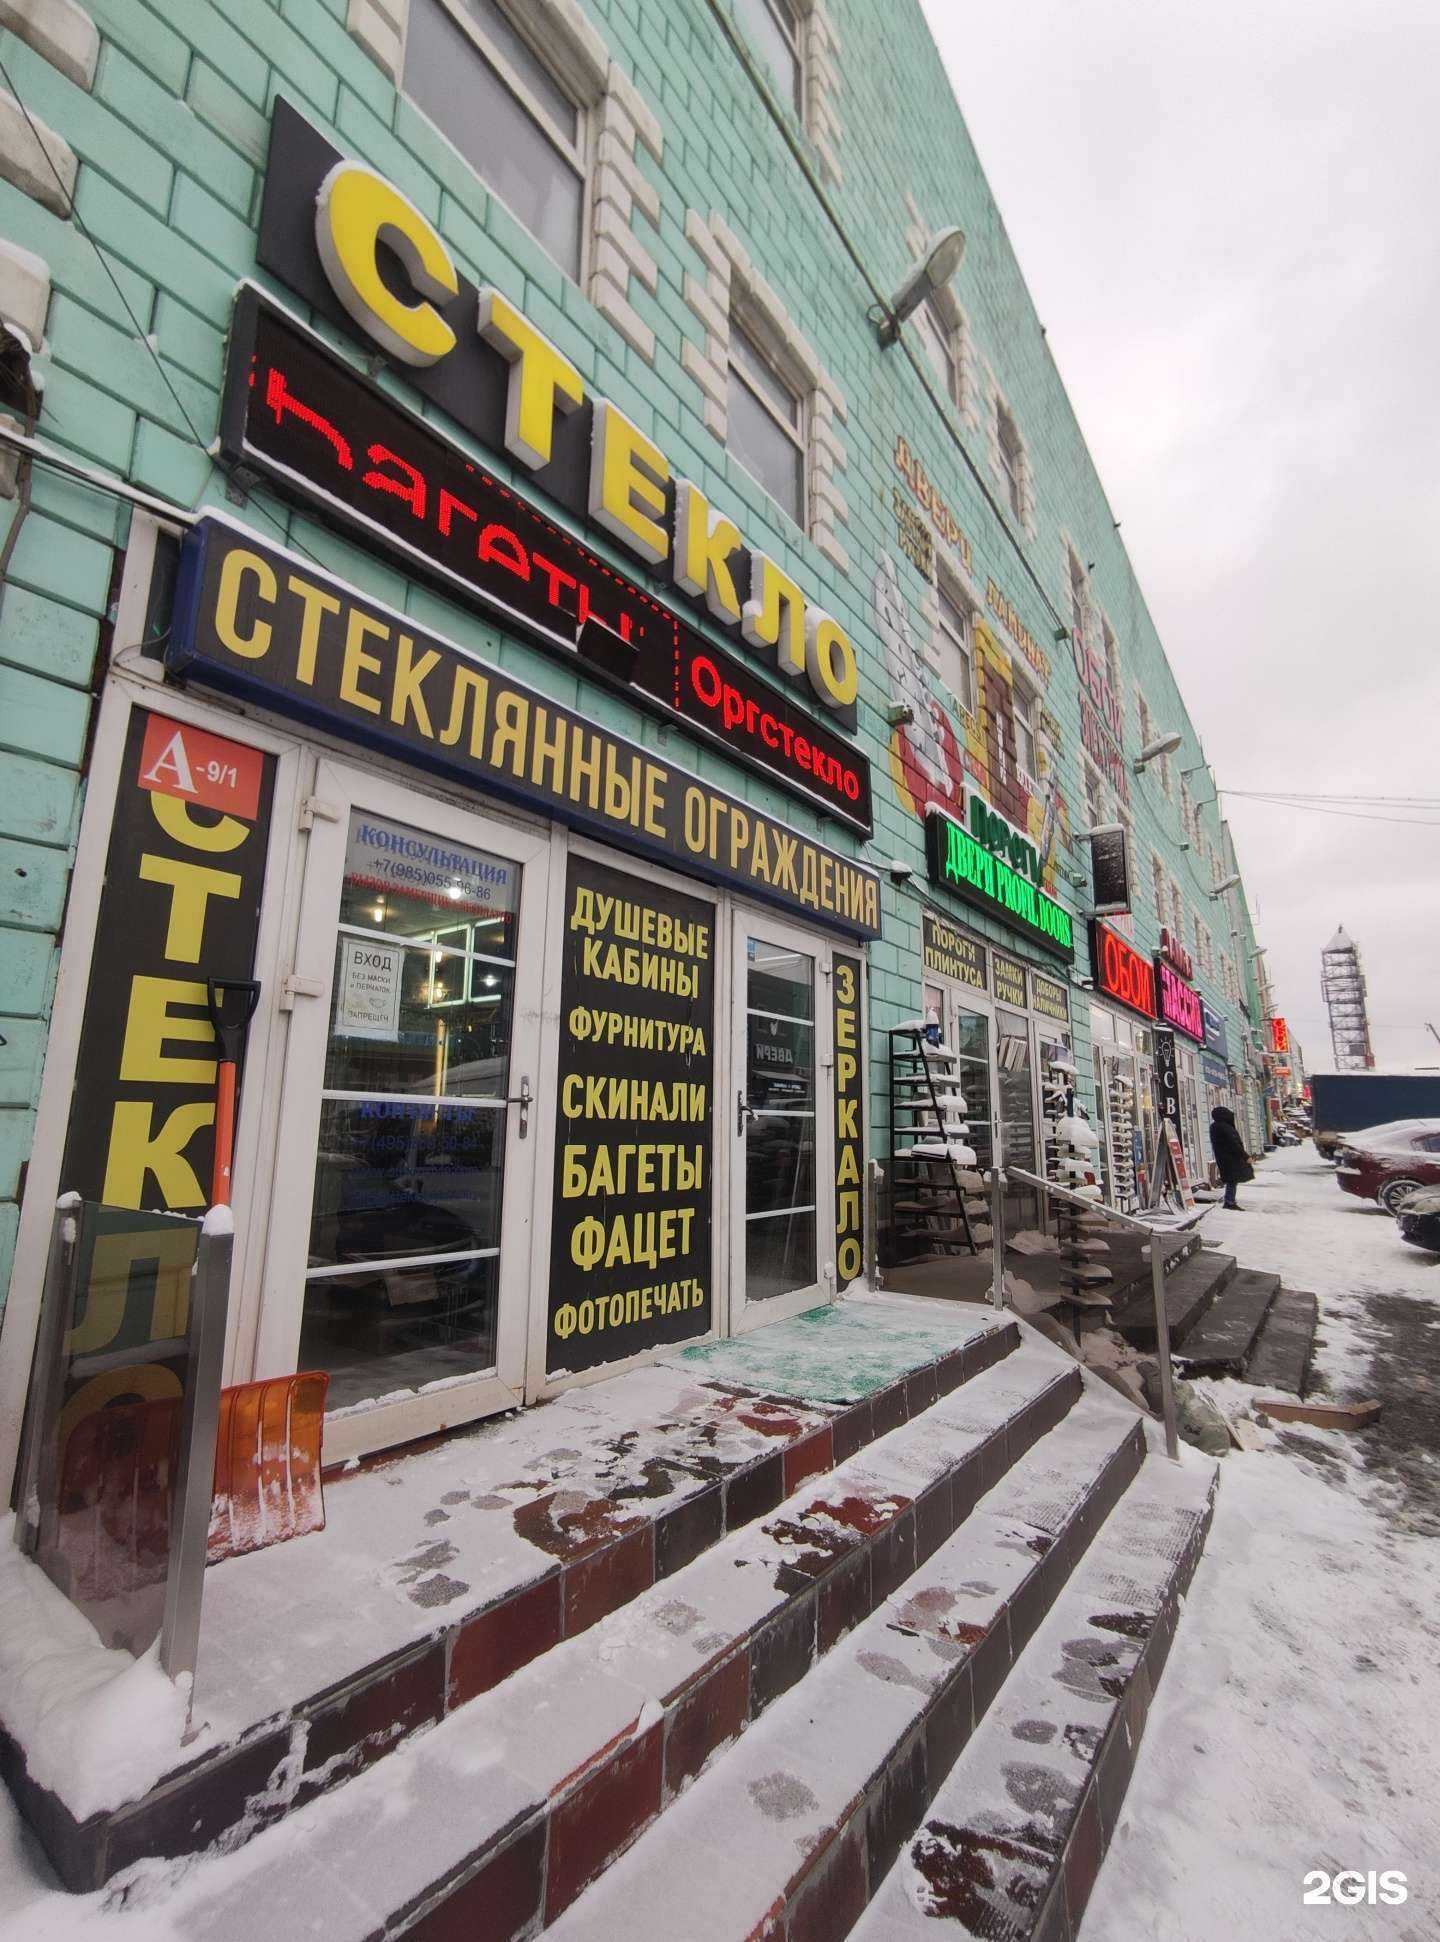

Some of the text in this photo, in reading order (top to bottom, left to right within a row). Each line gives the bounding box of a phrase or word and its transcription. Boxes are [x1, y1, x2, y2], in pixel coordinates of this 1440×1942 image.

[318, 160, 856, 708] СТЕКЛО
[215, 548, 668, 839] СТЕКЛЯННЫЕ
[684, 786, 879, 929] ОГРАЖДЕНИЯ
[691, 656, 860, 800] Оргстекло
[358, 824, 508, 885] КОНСУЛЬТАЦИЯ
[570, 886, 709, 960] ДУШЕВЫЕ
[931, 922, 976, 963] ПОРОГИ
[353, 951, 392, 970] ВХОД
[583, 936, 699, 999] КАБИНЫ
[925, 947, 983, 989] ПЛИНТУСА
[994, 958, 1023, 986] ЗАМКИ
[1104, 933, 1153, 1014] ОБОИ
[996, 980, 1024, 1008] РУЧКИ
[569, 1006, 706, 1057] ФУРНИТУРА
[562, 1073, 706, 1122] СКИНАЛИ
[836, 965, 861, 1281] ЗЕРКАЛО
[562, 1144, 703, 1199] БАГЕТЫ
[570, 1207, 696, 1273] ФАЦЕТ
[554, 1278, 705, 1340] ФОТОПЕЧАТЬ
